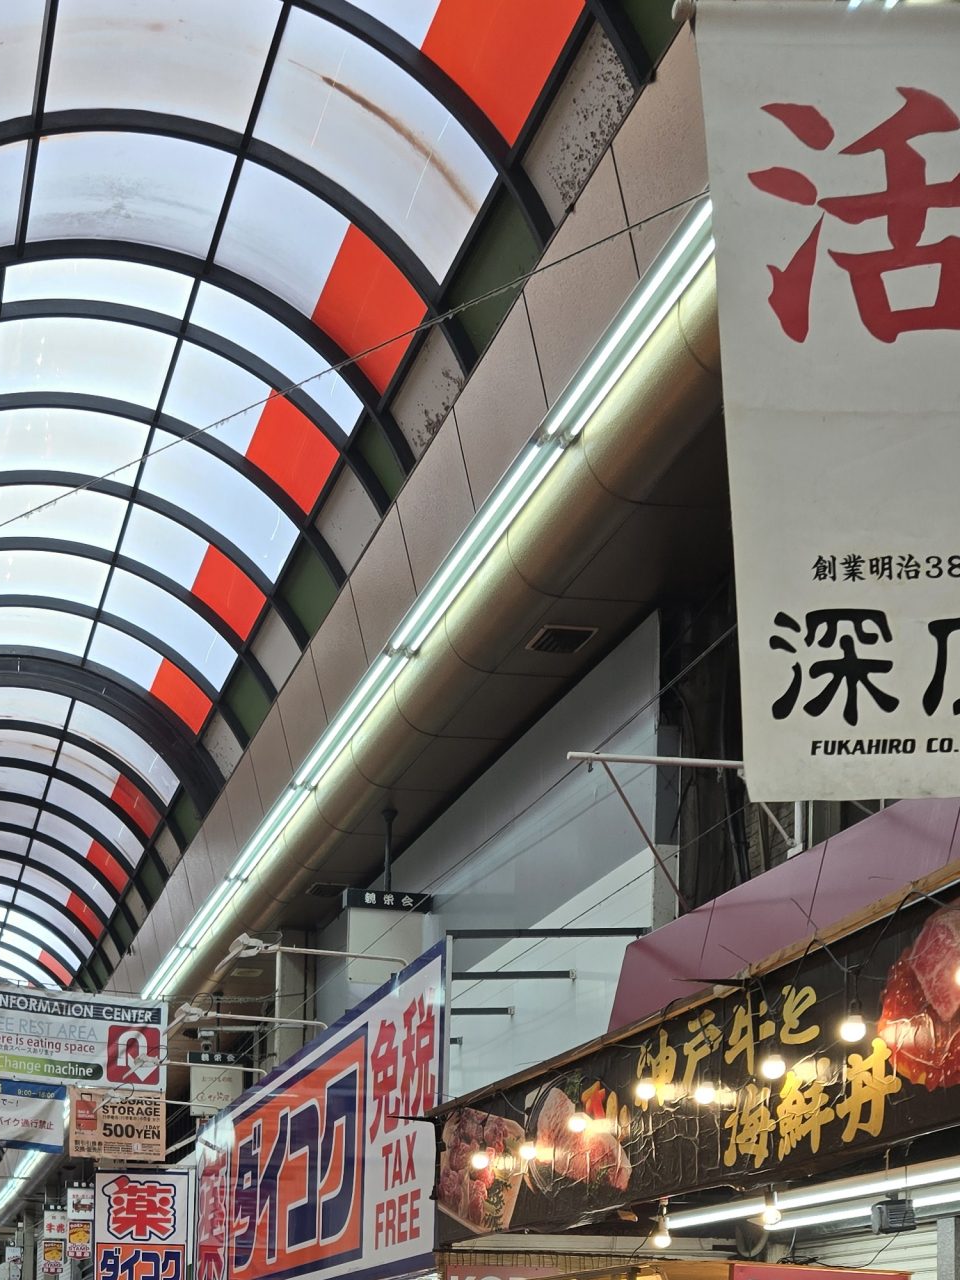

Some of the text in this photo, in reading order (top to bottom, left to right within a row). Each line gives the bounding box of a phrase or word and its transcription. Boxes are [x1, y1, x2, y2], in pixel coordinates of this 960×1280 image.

[747, 86, 960, 343] 活
[811, 737, 959, 756] FUKAHIRO CO.
[19, 1018, 53, 1036] REST
[56, 1024, 98, 1040] AREA
[102, 1006, 153, 1022] CENTER
[15, 1033, 24, 1045] is
[26, 1035, 61, 1053] eating
[65, 1042, 95, 1055] space
[44, 1063, 94, 1077] machine
[370, 990, 437, 1145] 免税
[102, 1105, 160, 1117] STORAGE
[232, 1062, 359, 1271] ダイコク
[382, 1131, 417, 1191] TAX
[104, 1176, 174, 1240] 薬
[375, 1189, 421, 1251] FREE
